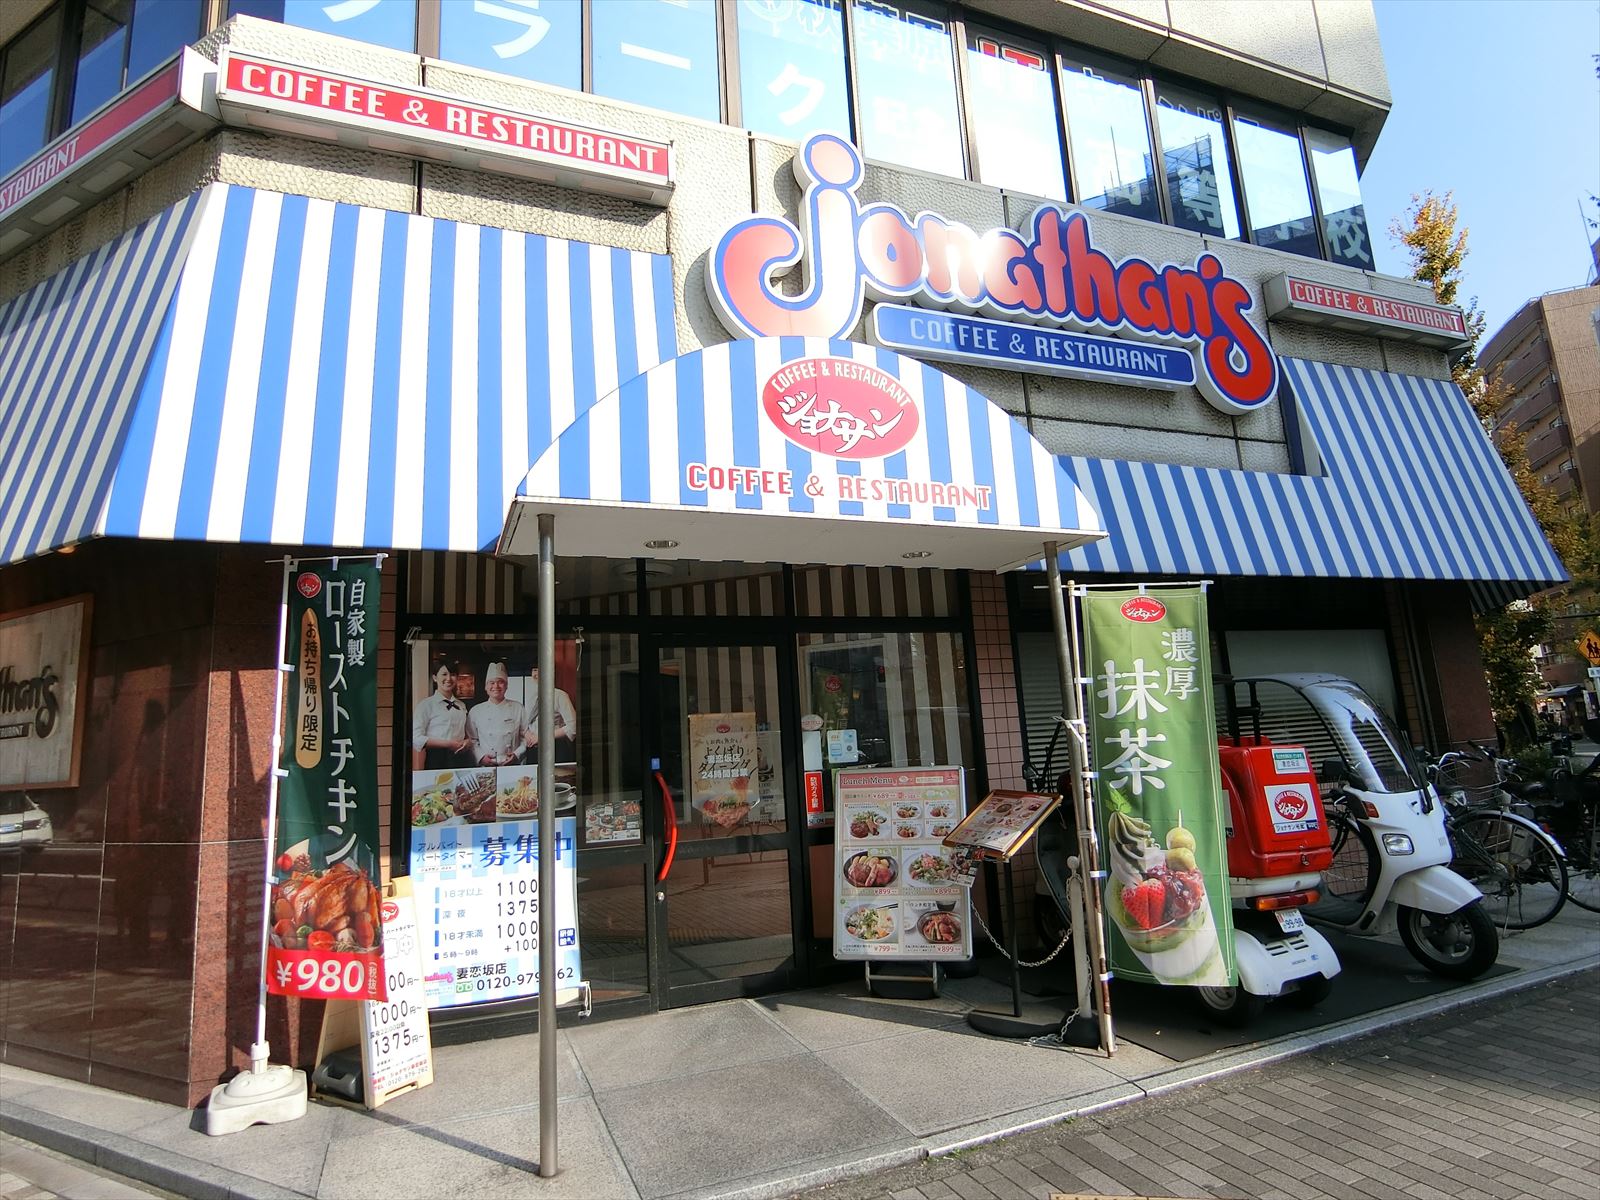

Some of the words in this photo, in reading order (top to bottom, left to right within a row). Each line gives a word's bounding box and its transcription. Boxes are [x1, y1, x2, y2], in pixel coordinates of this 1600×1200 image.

[241, 63, 387, 119] COFFEE
[401, 98, 430, 126] &
[446, 104, 659, 173] RESTAURANT
[1293, 283, 1352, 310] COFFEE
[1356, 296, 1369, 313] &
[1373, 298, 1460, 332] RESTAURANT
[909, 317, 1000, 352] COFFEE
[1008, 332, 1026, 355] &
[1034, 335, 1168, 374] RESTAURANT
[771, 362, 817, 393] COFFEE
[821, 363, 831, 377] &
[834, 361, 912, 408] RESTAURANT
[776, 391, 904, 454] ジョナサン
[688, 464, 792, 496] COFFEE
[805, 474, 825, 497] &
[838, 476, 991, 508] RESTAURANT
[347, 578, 367, 667] 自家製
[300, 622, 318, 752] お持ち帰り限定
[1160, 627, 1200, 701] 濃厚
[325, 579, 358, 867] ローストチキン
[1096, 658, 1173, 796] 抹茶
[416, 851, 475, 863] パートタイマー
[417, 841, 463, 852] アルバイト
[479, 831, 572, 868] 募集中
[497, 878, 538, 897] 1100
[497, 898, 538, 917] 1375
[497, 920, 538, 939] 1000
[276, 958, 365, 993] ¥980
[456, 962, 508, 980] 妻恋坂店
